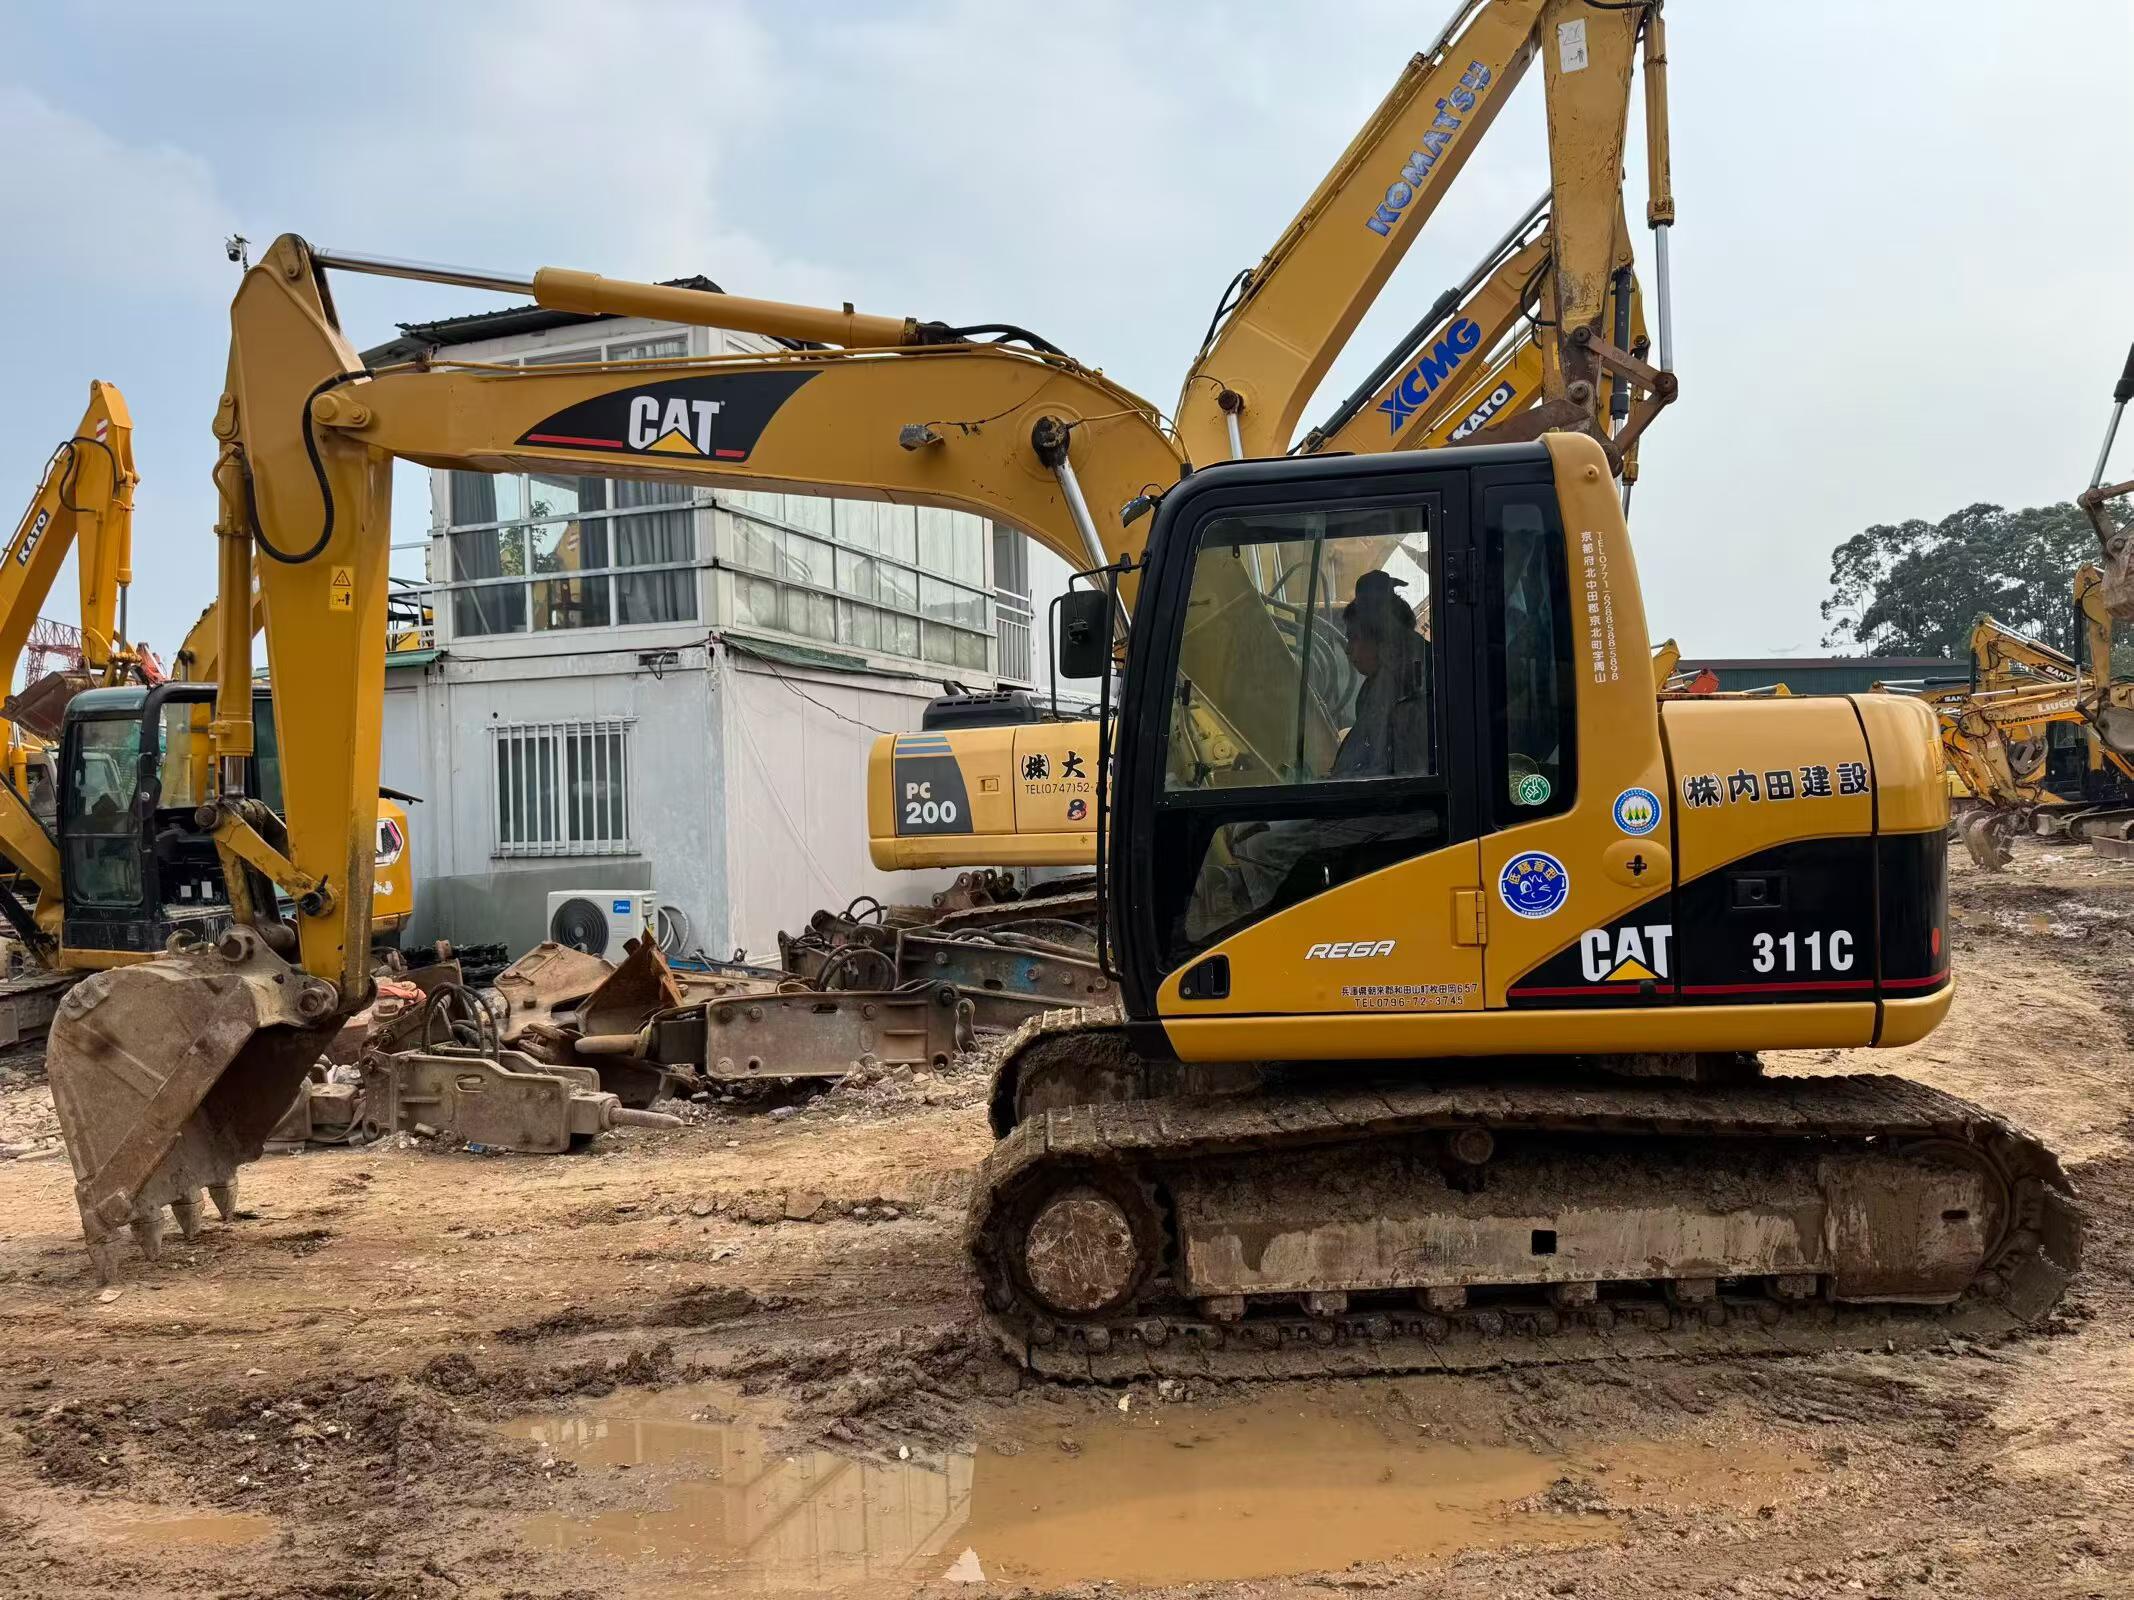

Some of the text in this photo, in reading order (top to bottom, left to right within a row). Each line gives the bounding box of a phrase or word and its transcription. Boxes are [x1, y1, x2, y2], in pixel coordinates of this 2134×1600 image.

[1367, 61, 1491, 237] KOMATSU
[1376, 317, 1481, 437] XCMG
[628, 395, 721, 456] CAT
[1452, 388, 1509, 440] KATO
[18, 513, 47, 562] KATO
[2045, 665, 2075, 682] SANY
[2038, 697, 2086, 713] LIUGO
[905, 781, 931, 799] PC
[1681, 762, 1871, 809] (株)内田建設
[905, 800, 957, 825] 200
[1303, 939, 1397, 961] REGA
[1580, 924, 1673, 982] CAT
[1752, 930, 1855, 973] 311C
[1354, 996, 1464, 1009] TEL0796-72-3745
